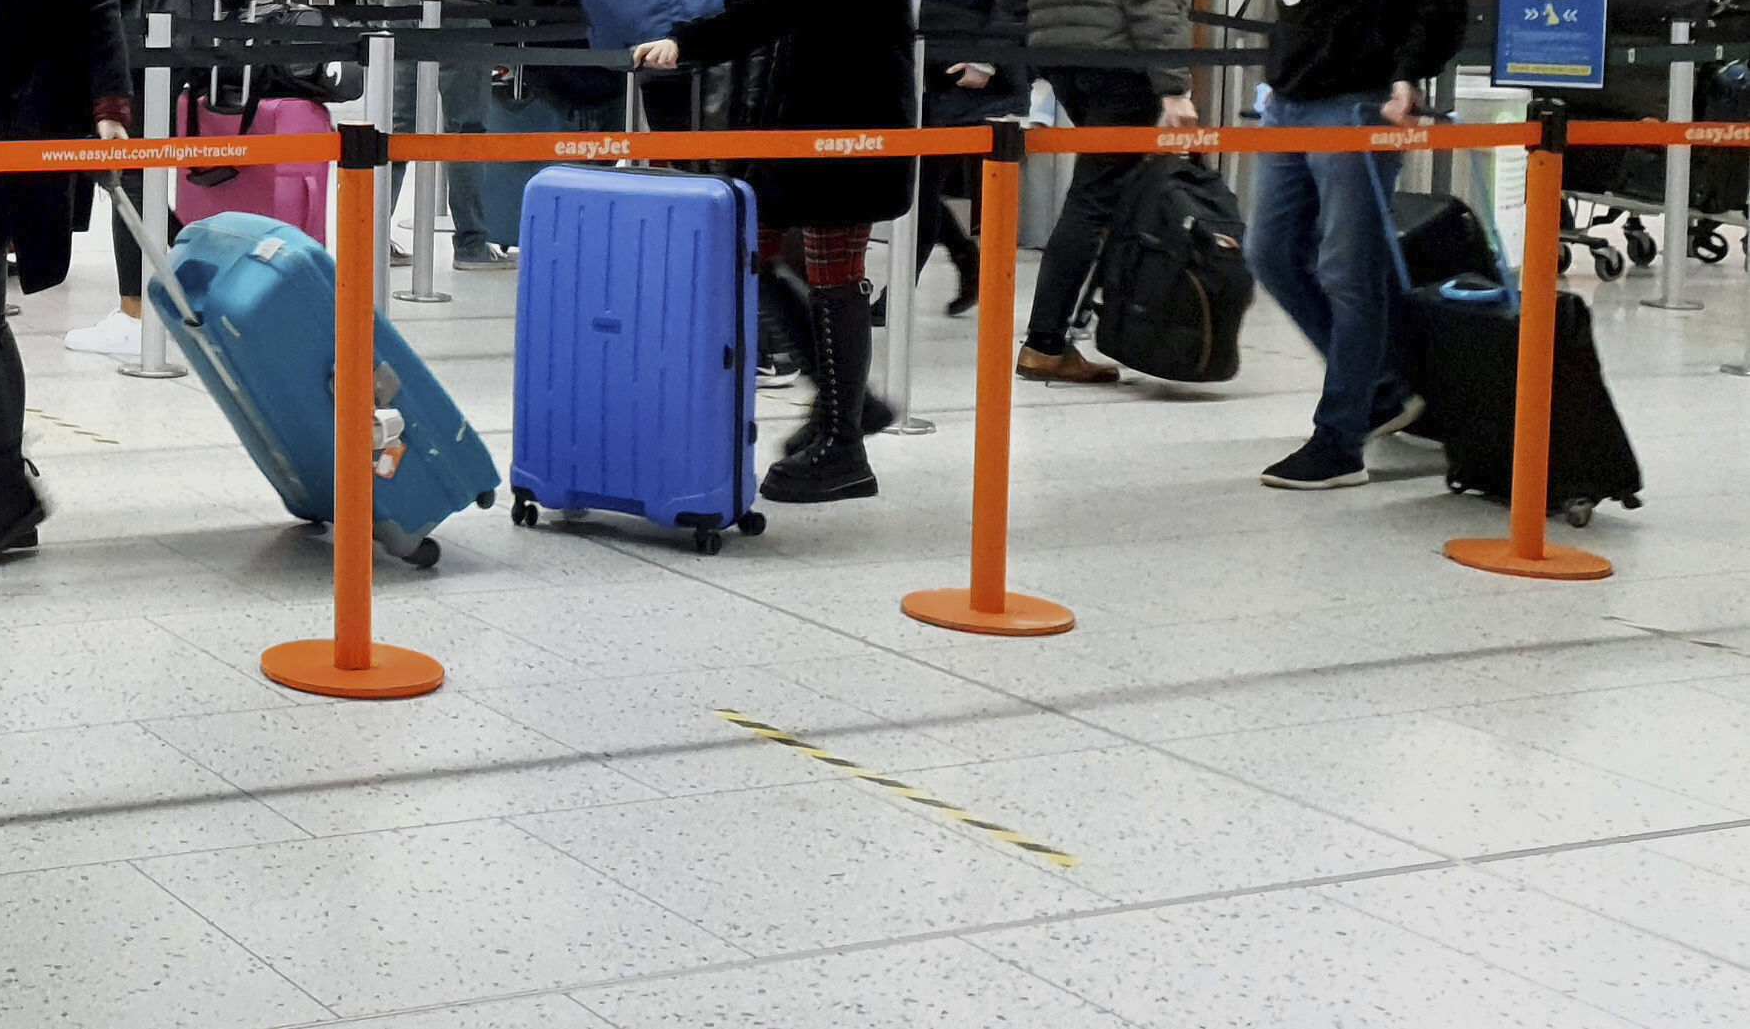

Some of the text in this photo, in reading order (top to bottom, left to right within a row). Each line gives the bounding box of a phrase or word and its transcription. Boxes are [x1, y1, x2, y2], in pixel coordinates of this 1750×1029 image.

[1157, 129, 1219, 150] easyJet
[1371, 128, 1428, 148] easyJet
[1684, 124, 1750, 143] easyJet
[41, 143, 249, 162] www.easyJet.com/flight-tracker
[554, 136, 630, 159] easyJet
[814, 134, 884, 155] easyJet
